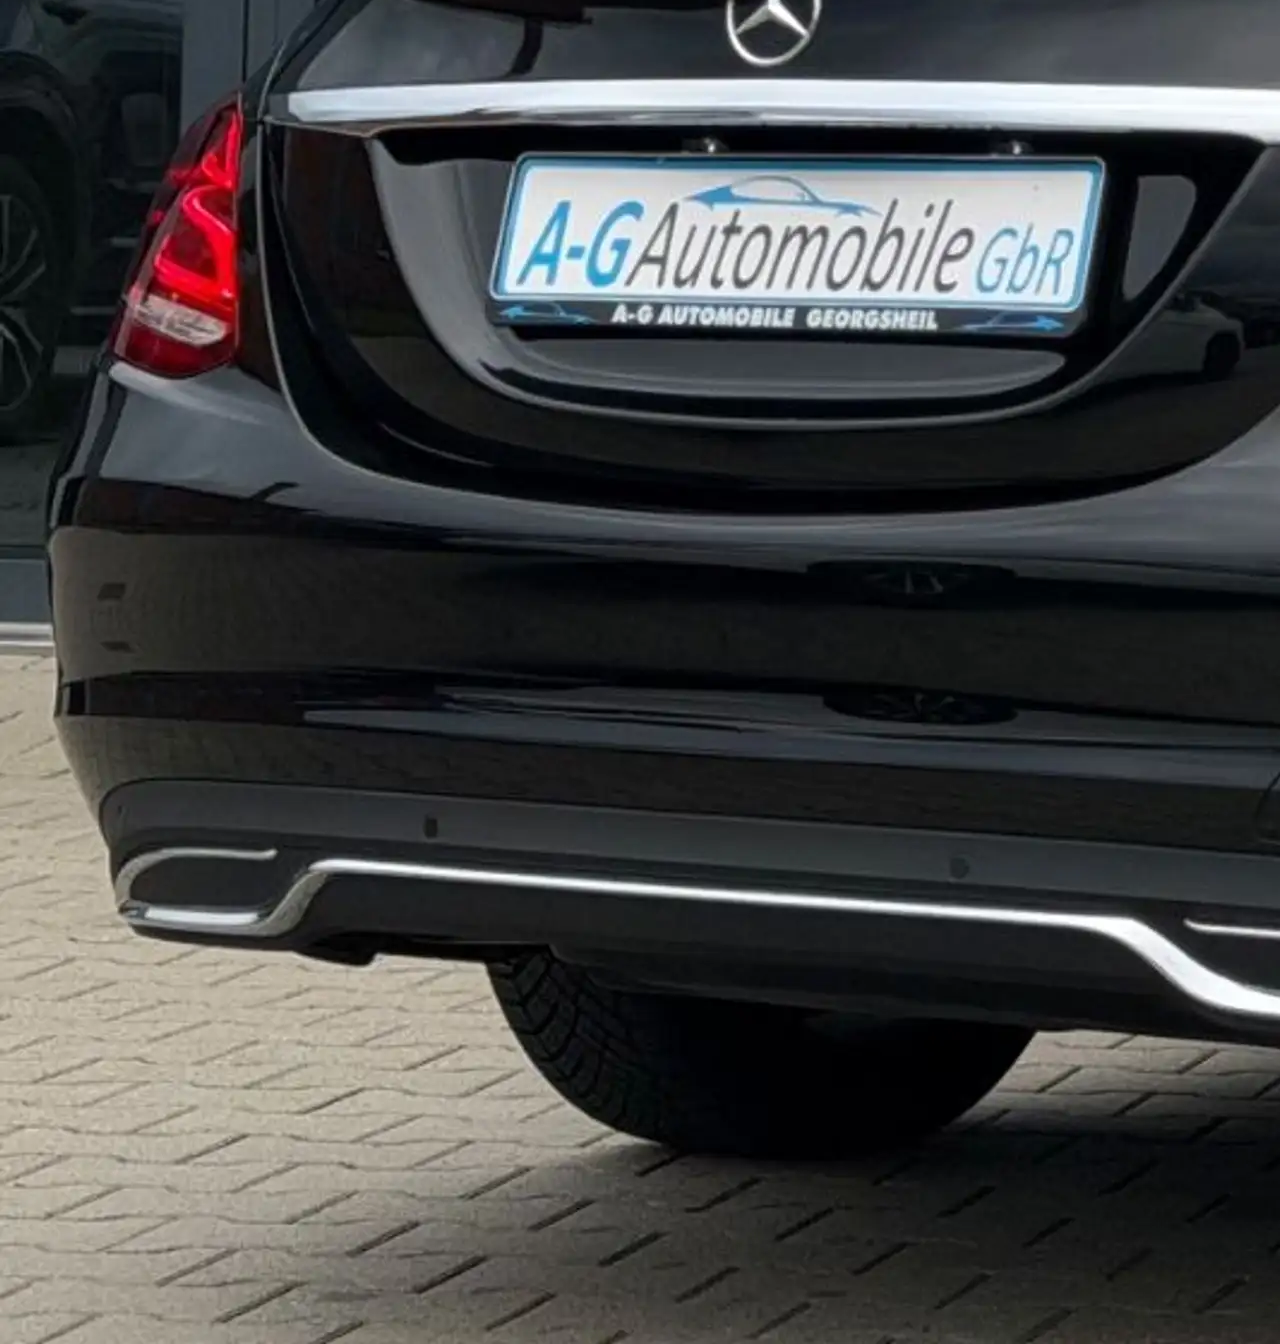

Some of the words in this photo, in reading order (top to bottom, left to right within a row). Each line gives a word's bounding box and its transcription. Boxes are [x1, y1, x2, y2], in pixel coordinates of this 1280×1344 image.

[624, 197, 976, 294] Automobile
[974, 222, 1075, 295] GbR
[610, 303, 654, 325] A-G
[657, 304, 796, 328] AUTOMOBILE
[805, 309, 938, 331] GEORGSHEIL
